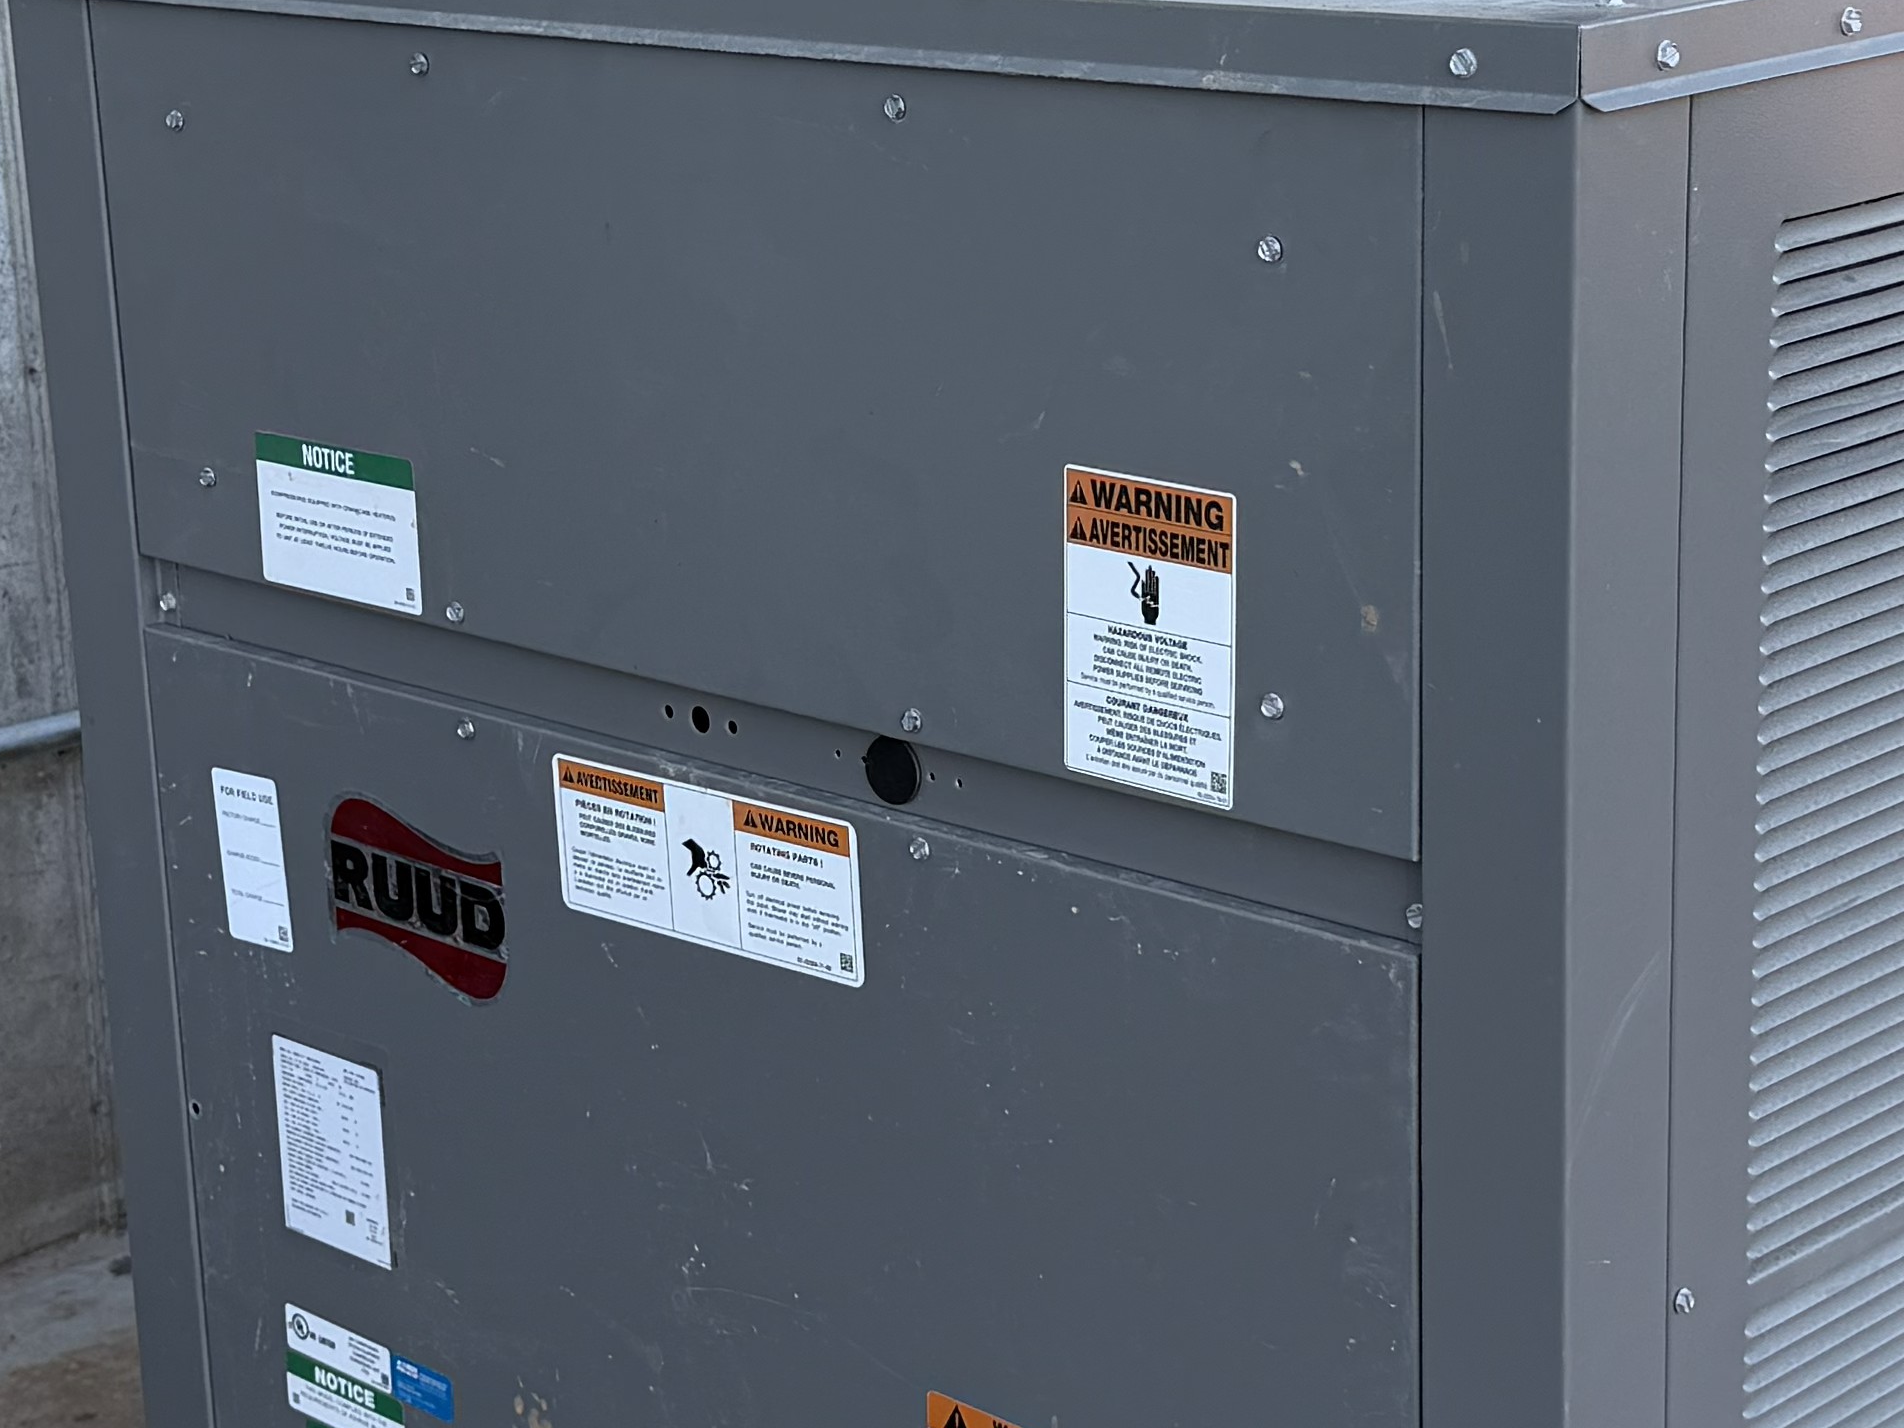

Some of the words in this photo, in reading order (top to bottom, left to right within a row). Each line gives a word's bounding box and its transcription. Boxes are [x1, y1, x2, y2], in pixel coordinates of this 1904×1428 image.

[301, 443, 354, 475] NOTICE
[1090, 478, 1223, 531] WARNING
[1089, 516, 1228, 569] AVERTISSEMENT
[575, 769, 658, 805] AVERTISSEMENT
[758, 812, 839, 849] WARNING
[331, 839, 506, 951] RUUD
[314, 1365, 375, 1410] NOTICE
